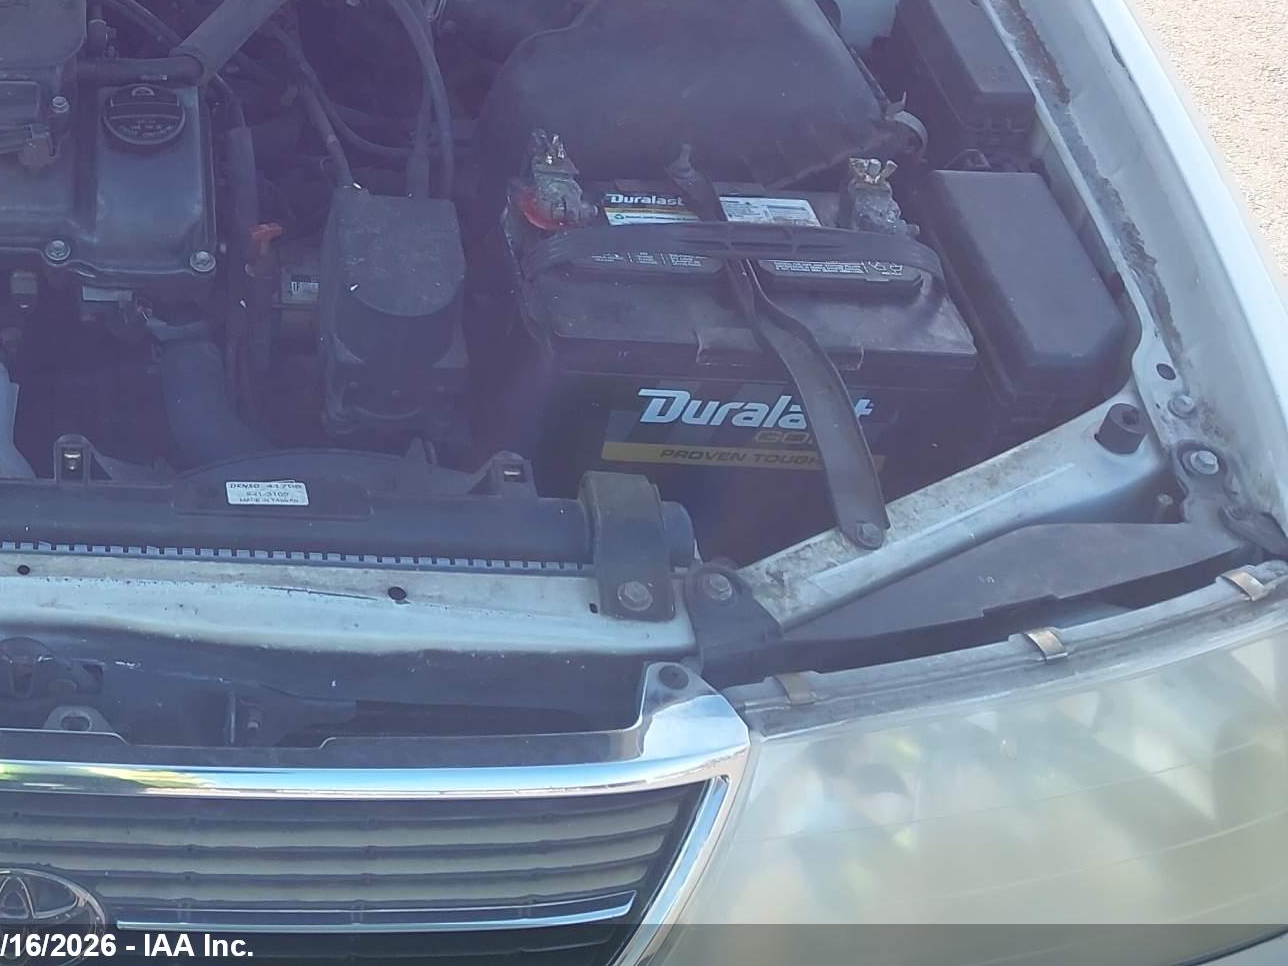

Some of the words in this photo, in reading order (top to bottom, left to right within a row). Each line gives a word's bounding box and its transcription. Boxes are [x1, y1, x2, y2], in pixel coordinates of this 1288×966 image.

[606, 193, 685, 206] Duralast
[638, 389, 874, 430] Duralat
[661, 449, 747, 463] PROVEN
